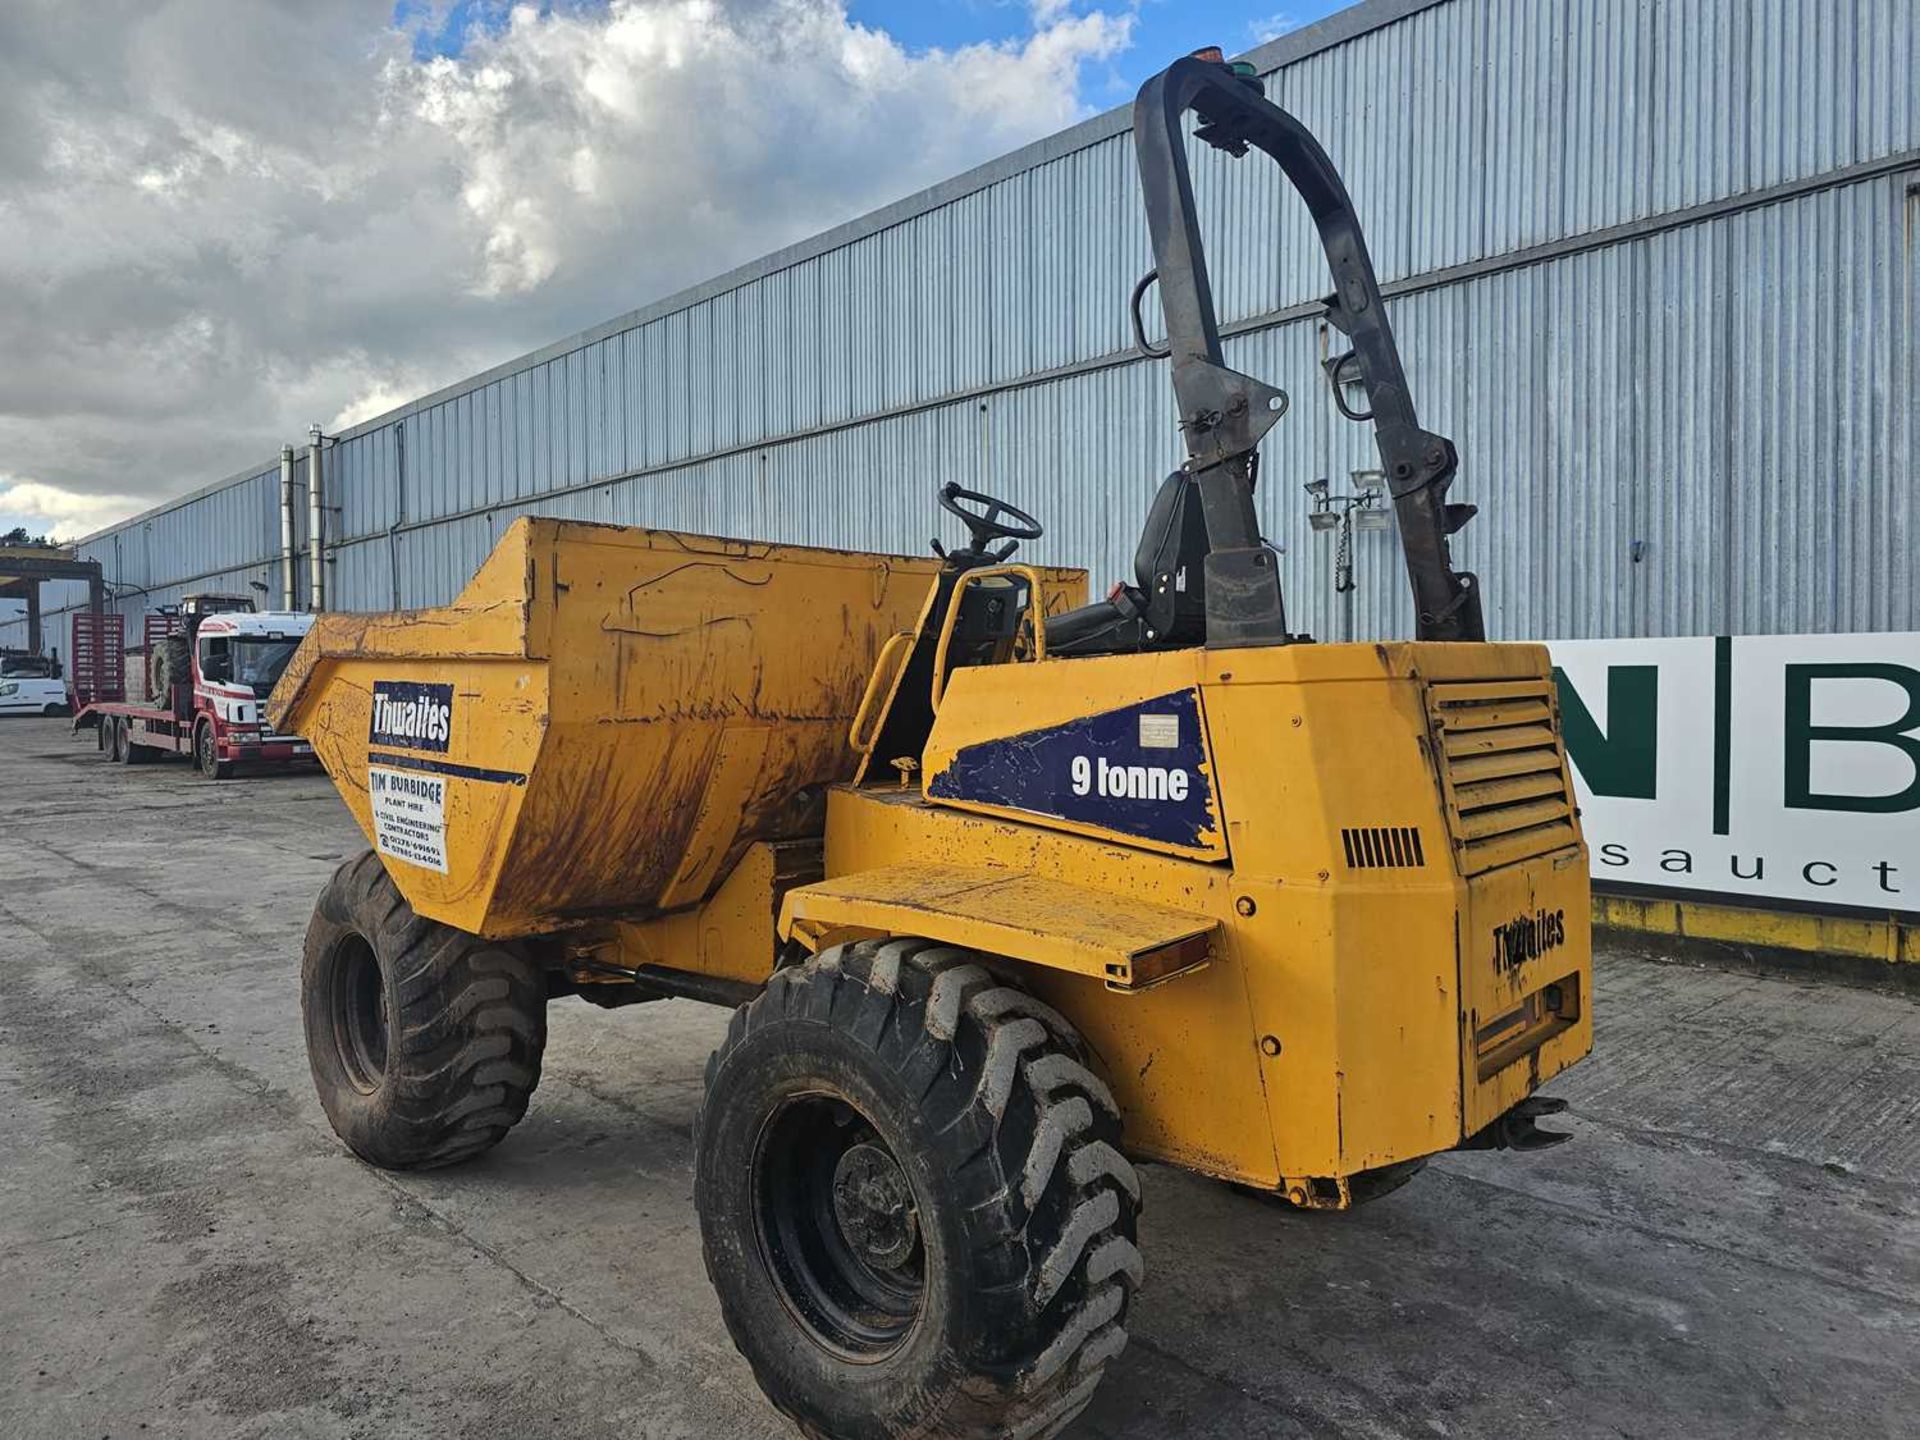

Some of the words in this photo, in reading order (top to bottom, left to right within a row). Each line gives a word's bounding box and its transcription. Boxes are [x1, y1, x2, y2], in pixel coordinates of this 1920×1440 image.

[374, 693, 450, 742] Thwaites
[1784, 662, 1920, 813] B
[370, 772, 386, 791] TIM
[390, 775, 442, 804] BURBIDGE
[1071, 755, 1091, 796] 9
[1098, 757, 1189, 801] tonne
[384, 796, 406, 809] PLANT
[408, 801, 424, 812] HIRE
[380, 811, 395, 822] CIVIL
[396, 815, 441, 833] ENGINEERING
[383, 822, 430, 841] CONTRACTORS
